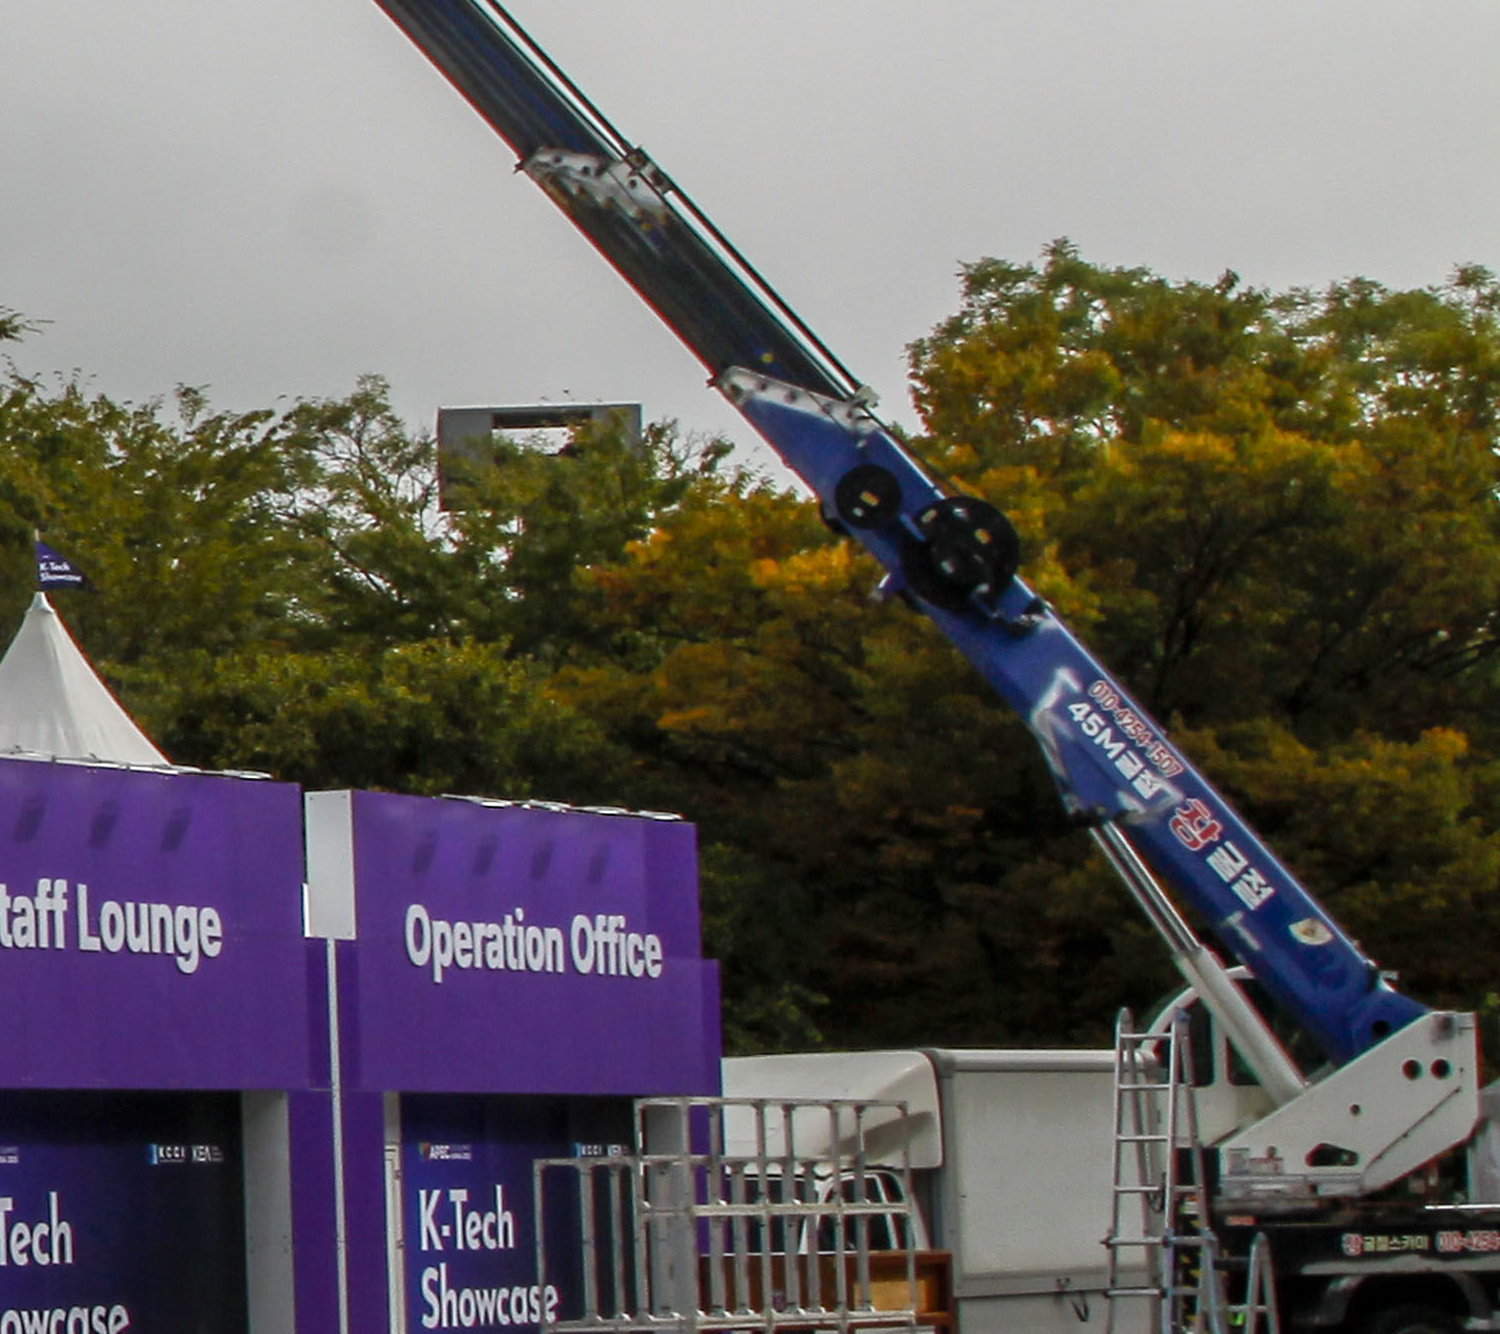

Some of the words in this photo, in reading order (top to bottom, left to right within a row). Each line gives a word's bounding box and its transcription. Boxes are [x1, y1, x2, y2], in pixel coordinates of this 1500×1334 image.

[76, 882, 223, 975] Lounge
[404, 903, 565, 984] Operation
[570, 914, 663, 979] Office
[418, 1184, 515, 1252] K-Tech
[420, 1262, 560, 1329] Showcase
